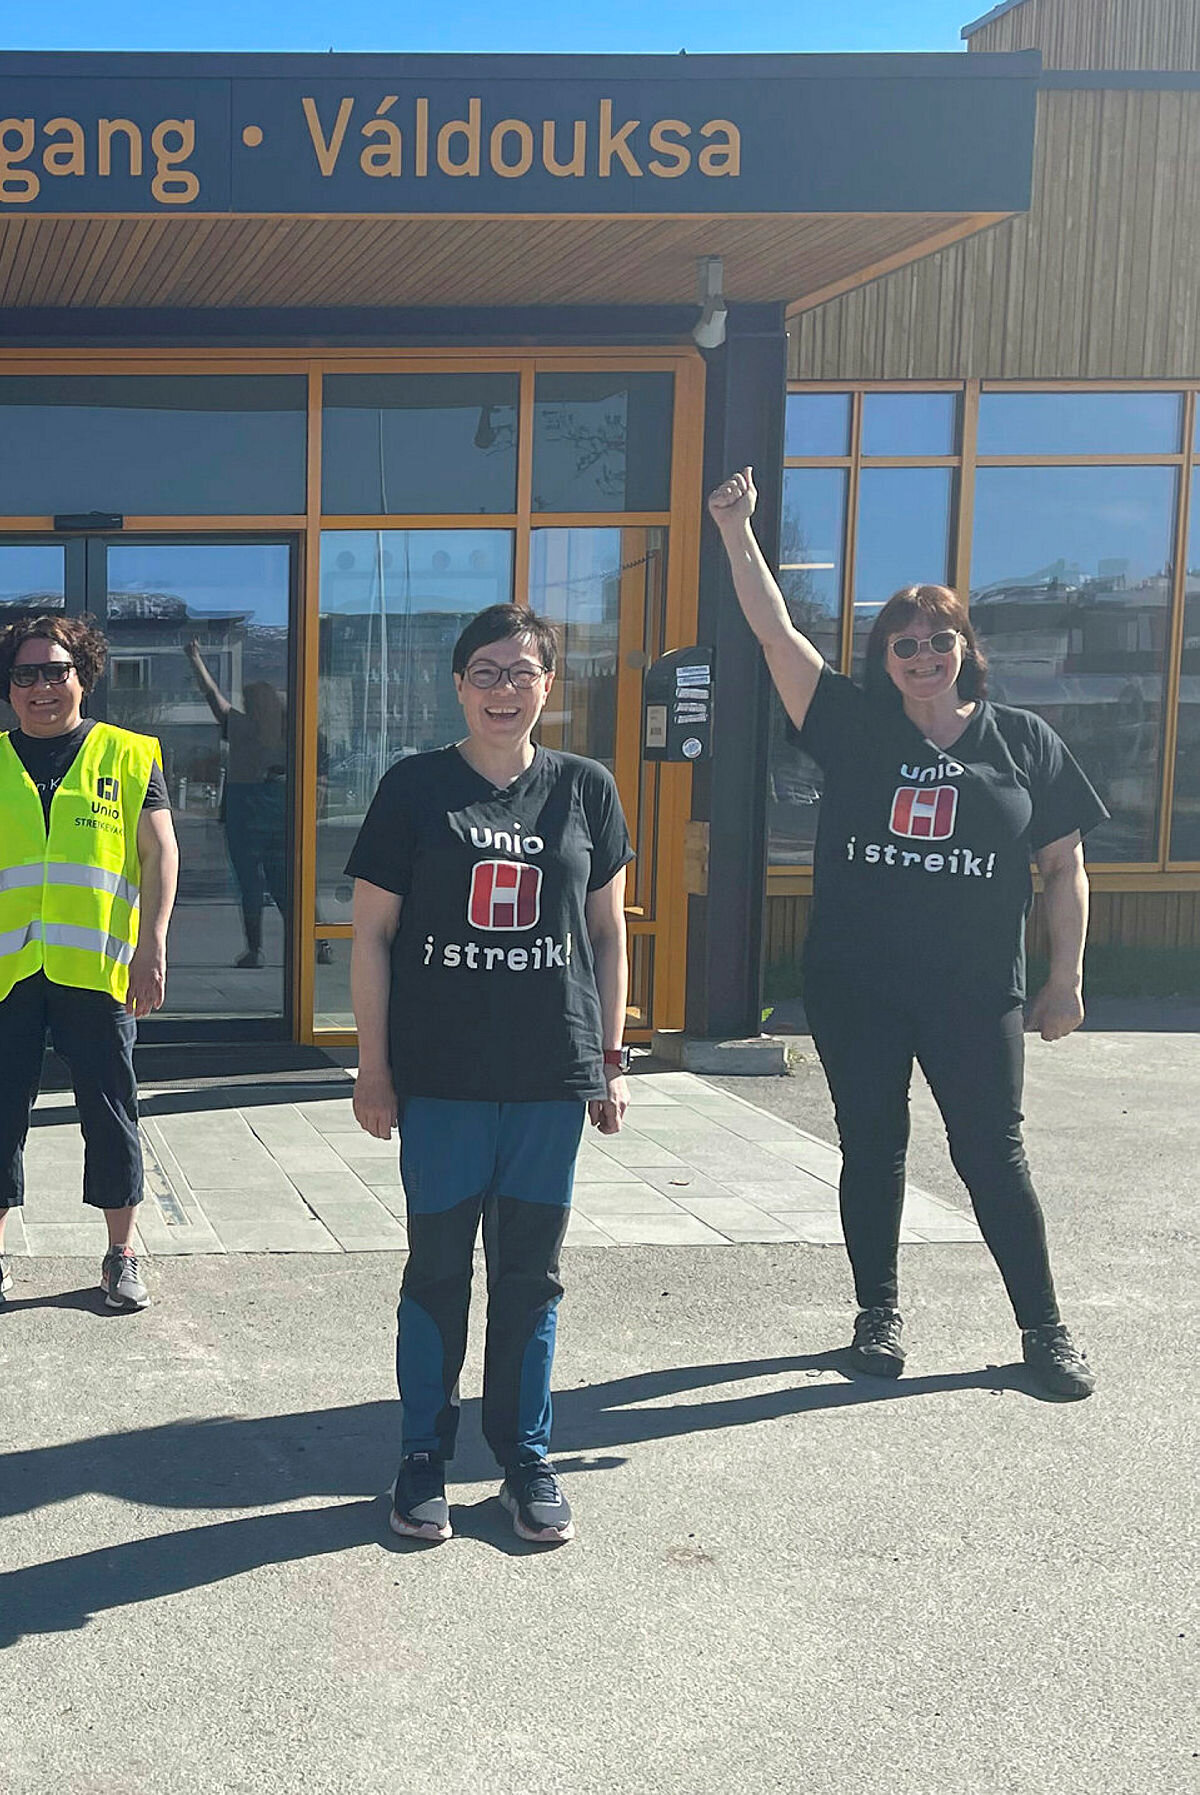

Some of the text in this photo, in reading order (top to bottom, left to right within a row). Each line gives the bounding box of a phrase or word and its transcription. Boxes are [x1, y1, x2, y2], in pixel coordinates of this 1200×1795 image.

[302, 95, 741, 178] Váldouksa
[900, 753, 965, 782] Unio
[91, 801, 120, 820] Unio
[470, 822, 544, 854] Unio
[847, 836, 996, 879] i streik!
[424, 932, 572, 971] i streik!
